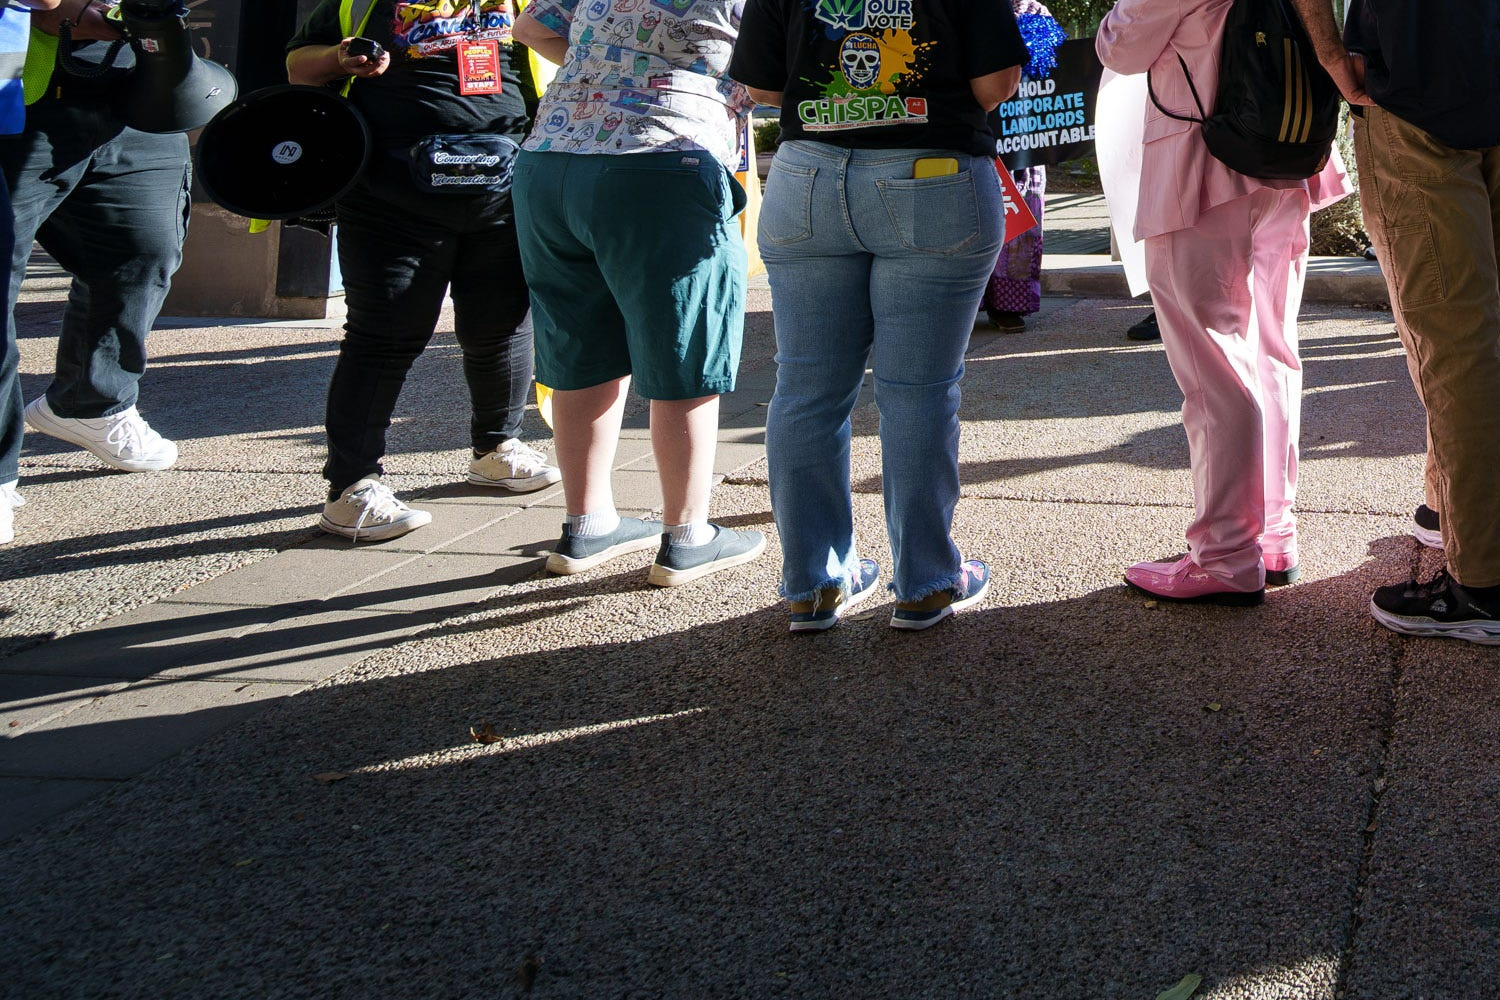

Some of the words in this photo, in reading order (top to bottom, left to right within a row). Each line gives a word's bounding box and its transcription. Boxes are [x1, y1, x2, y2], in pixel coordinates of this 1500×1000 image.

[867, 0, 911, 15] OUR
[867, 15, 911, 28] VOTE
[1018, 79, 1056, 98] HOLD
[999, 92, 1085, 118] CORPORATE
[1002, 110, 1085, 136] LANDLORDS
[996, 124, 1096, 154] ACCOUNTABLE
[434, 151, 501, 167] Connecting
[431, 172, 501, 187] Generations
